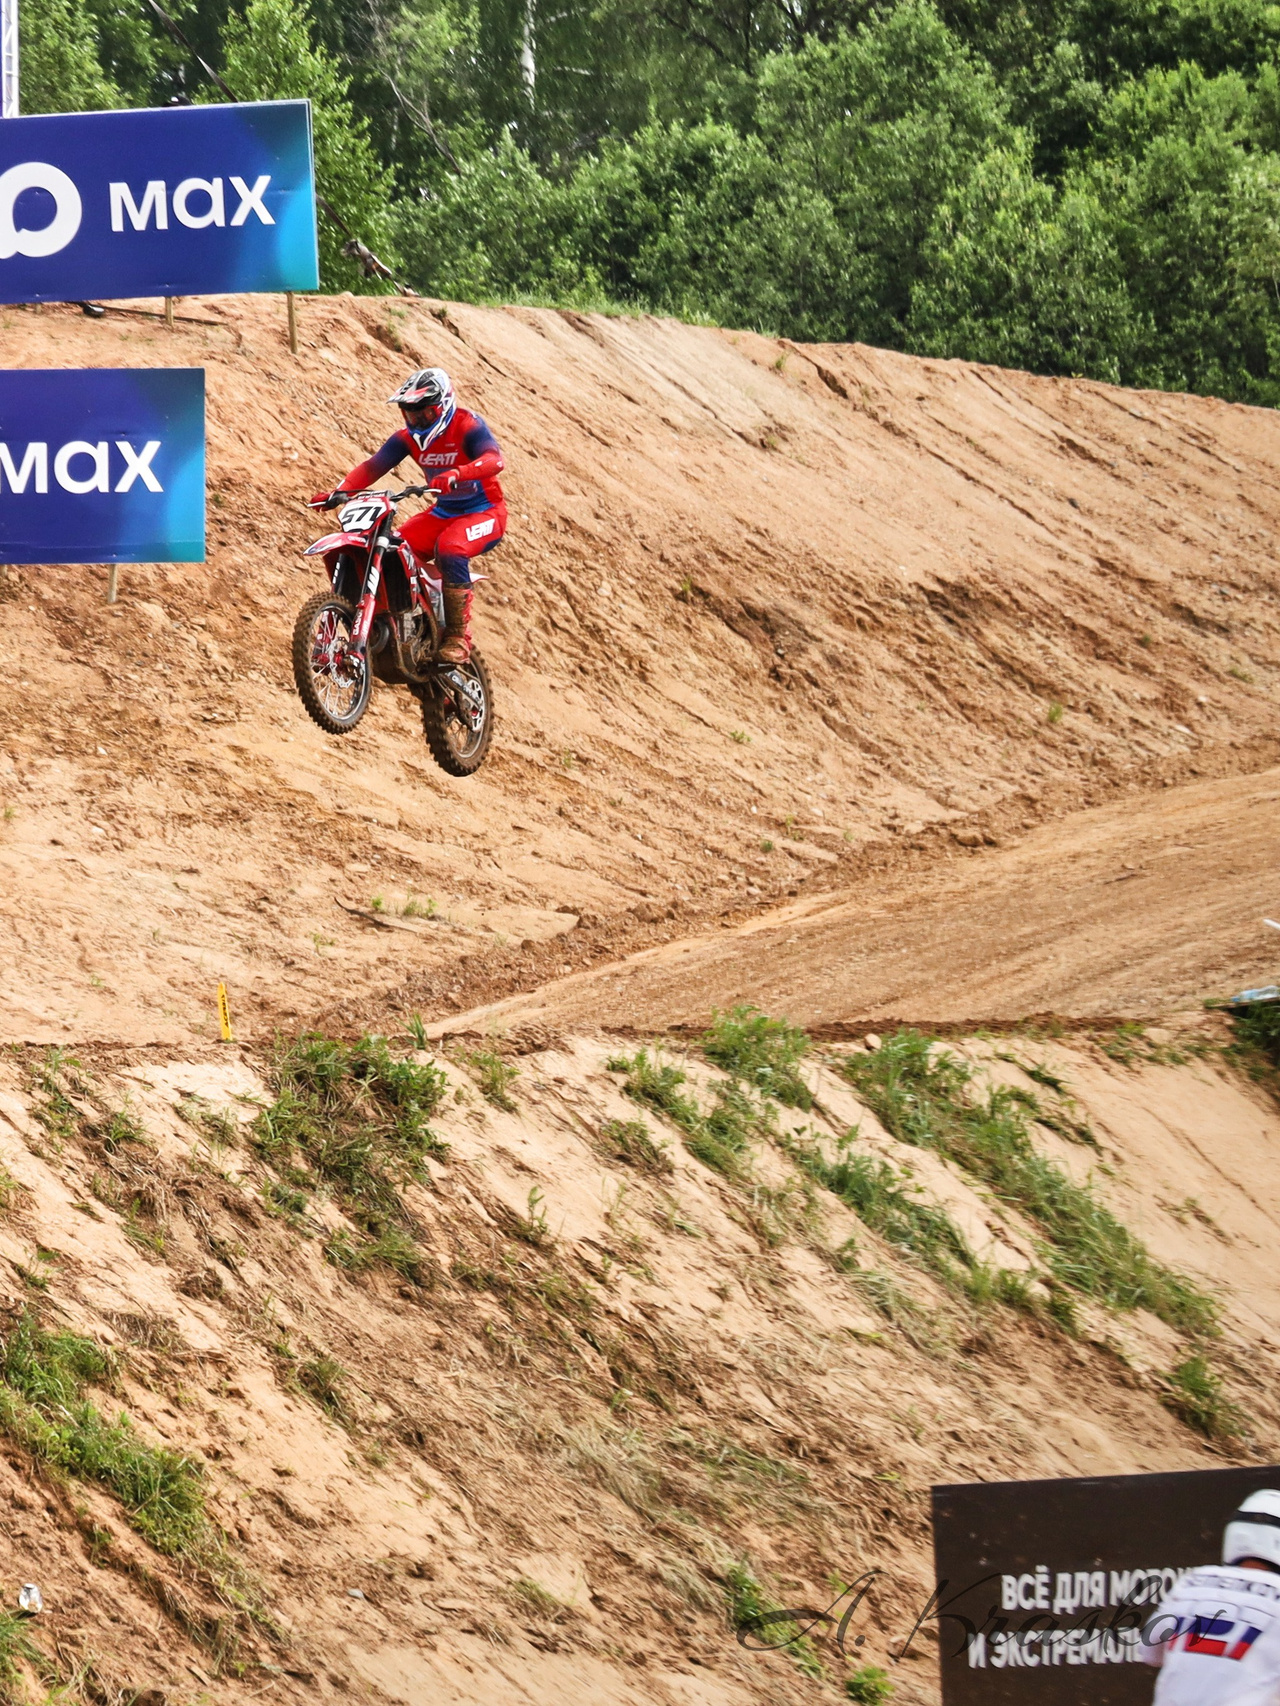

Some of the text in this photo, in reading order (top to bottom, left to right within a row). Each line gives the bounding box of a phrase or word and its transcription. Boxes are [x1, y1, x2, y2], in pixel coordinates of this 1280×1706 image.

[341, 506, 383, 525] 571
[1001, 1565, 1050, 1611] ВСЁ
[1053, 1571, 1106, 1615] ДЛЯ
[967, 1632, 988, 1669] И
